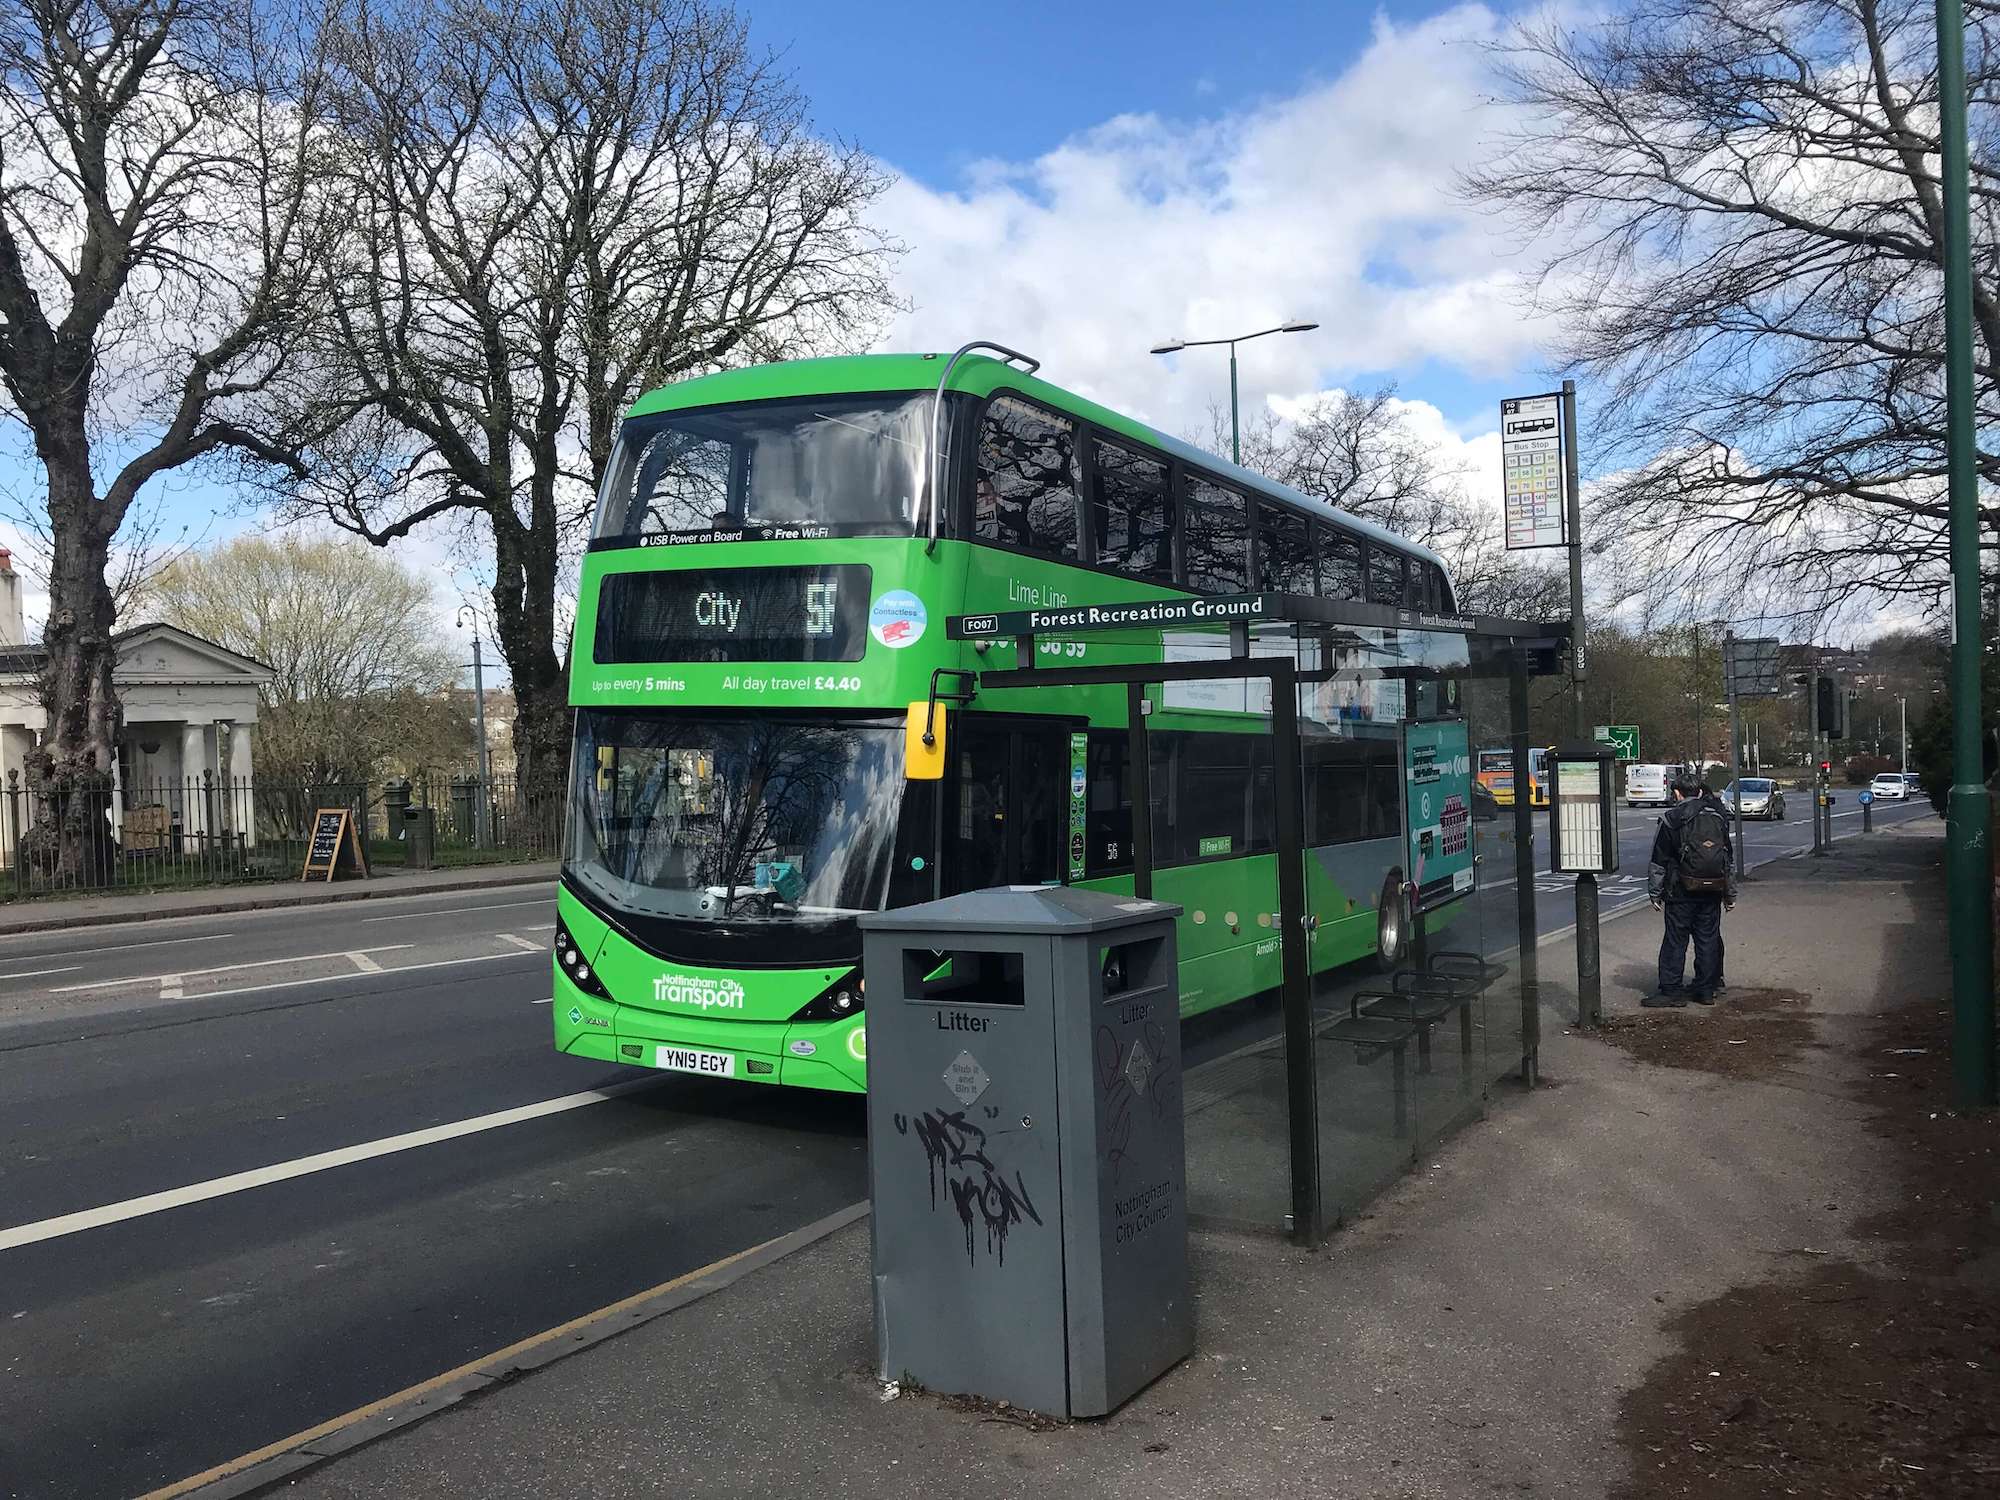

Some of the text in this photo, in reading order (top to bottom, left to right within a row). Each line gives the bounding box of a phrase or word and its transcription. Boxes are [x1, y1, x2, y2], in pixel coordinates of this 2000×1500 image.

[1514, 441, 1549, 451] Bus Stop
[649, 530, 743, 546] USB Power on Board
[775, 527, 829, 539] Free Wi-Fi
[1009, 578, 1067, 608] Lime Line
[696, 592, 741, 633] City
[873, 607, 918, 617] Contactless
[1031, 597, 1263, 628] Forest Recreation Ground
[967, 619, 993, 631] FO07
[592, 677, 686, 693] Up to every 5 mins
[722, 676, 861, 693] All day travel £4.40
[1256, 941, 1274, 957] Arnold
[662, 973, 741, 992] Nottingham City
[652, 979, 745, 1010] Transport
[937, 1011, 990, 1033] Litter
[1122, 1004, 1150, 1025] Litter
[667, 1049, 728, 1073] YN19 EGY
[1115, 1180, 1170, 1217] Nottingham
[1117, 1199, 1173, 1243] City Council
